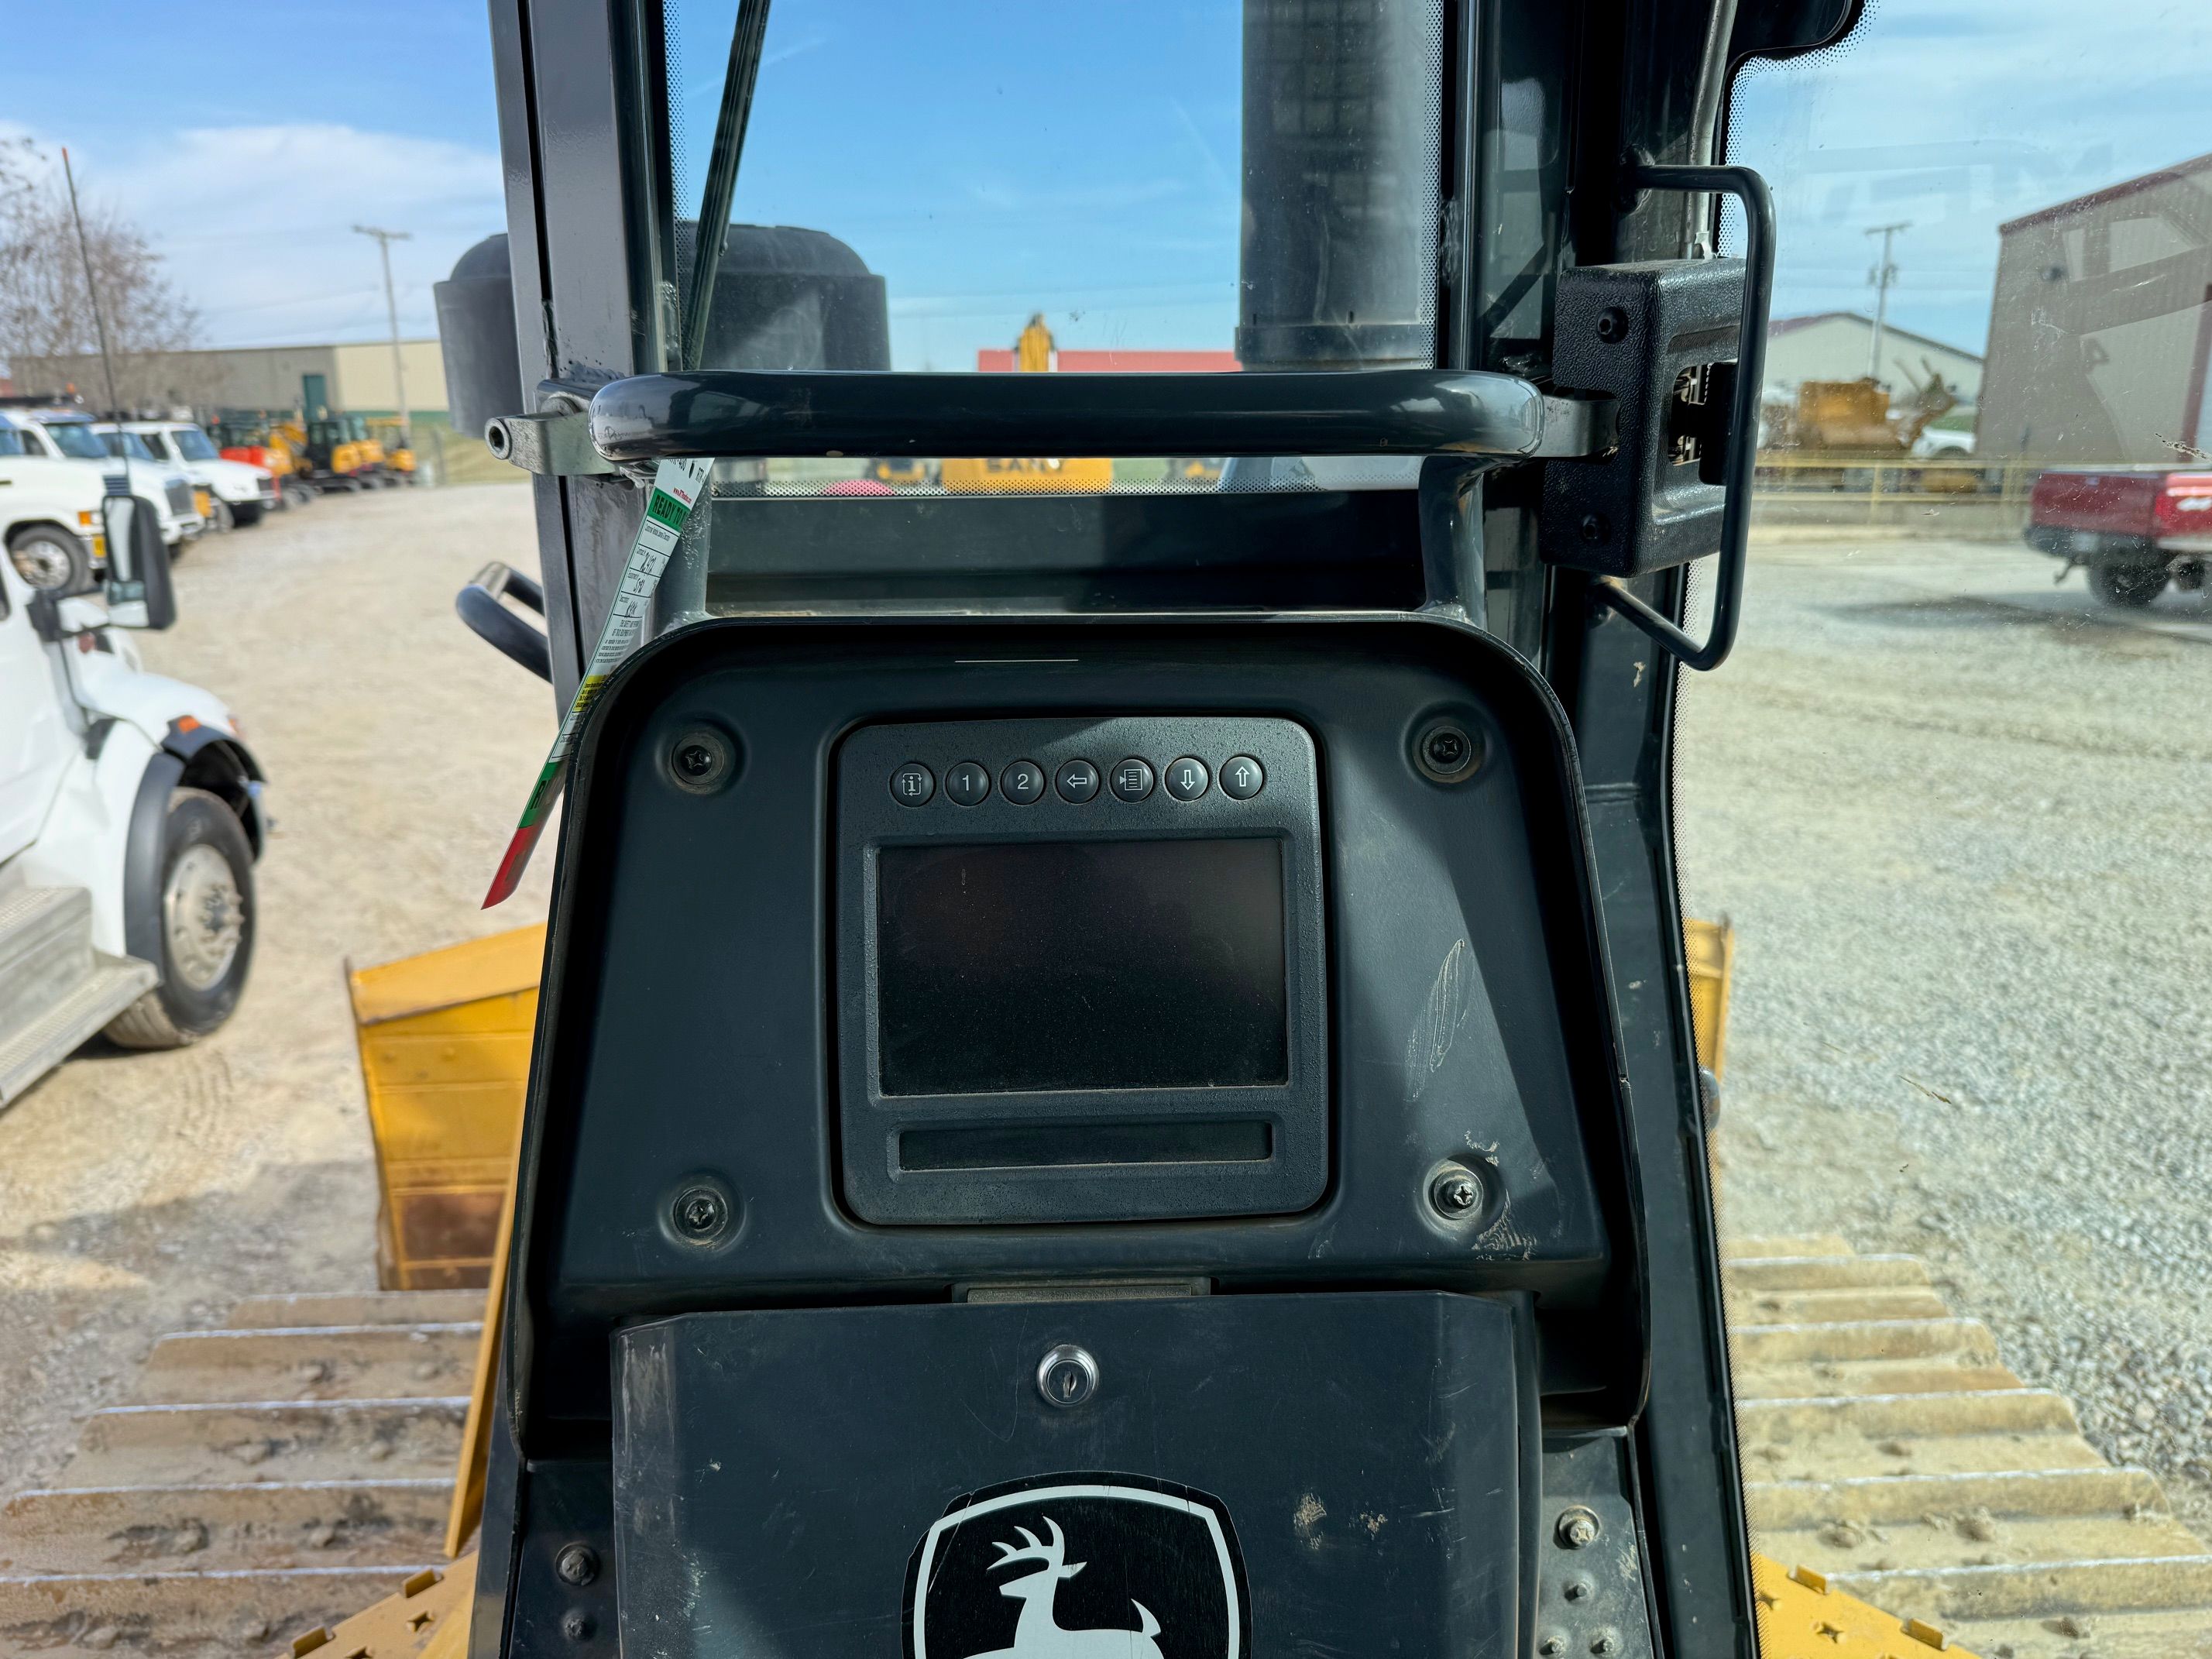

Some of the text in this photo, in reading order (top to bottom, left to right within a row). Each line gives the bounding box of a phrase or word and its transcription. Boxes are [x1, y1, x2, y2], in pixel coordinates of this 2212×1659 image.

[652, 494, 677, 521] READY
[674, 507, 683, 525] TO
[962, 775, 969, 791] 1
[1017, 773, 1029, 790] 2
